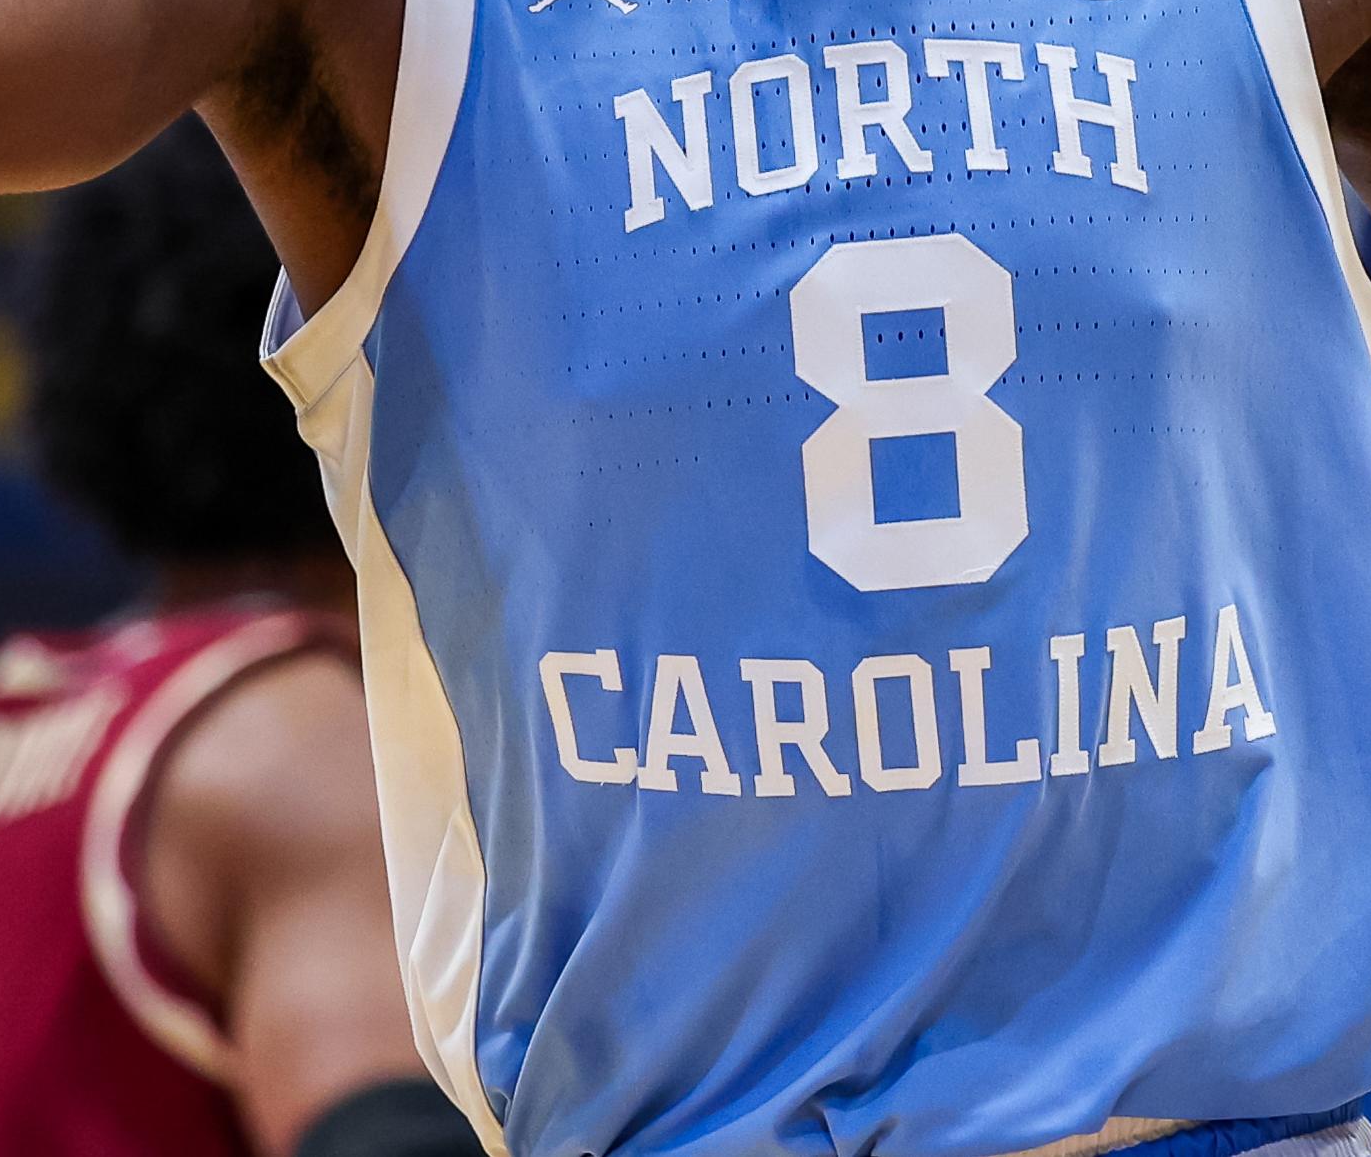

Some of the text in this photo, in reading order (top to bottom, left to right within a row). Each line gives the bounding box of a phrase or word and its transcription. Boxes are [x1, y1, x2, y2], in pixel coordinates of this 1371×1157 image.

[613, 39, 1148, 232] NORTH
[789, 233, 1030, 592] 8
[539, 604, 1275, 797] CAROLINA
